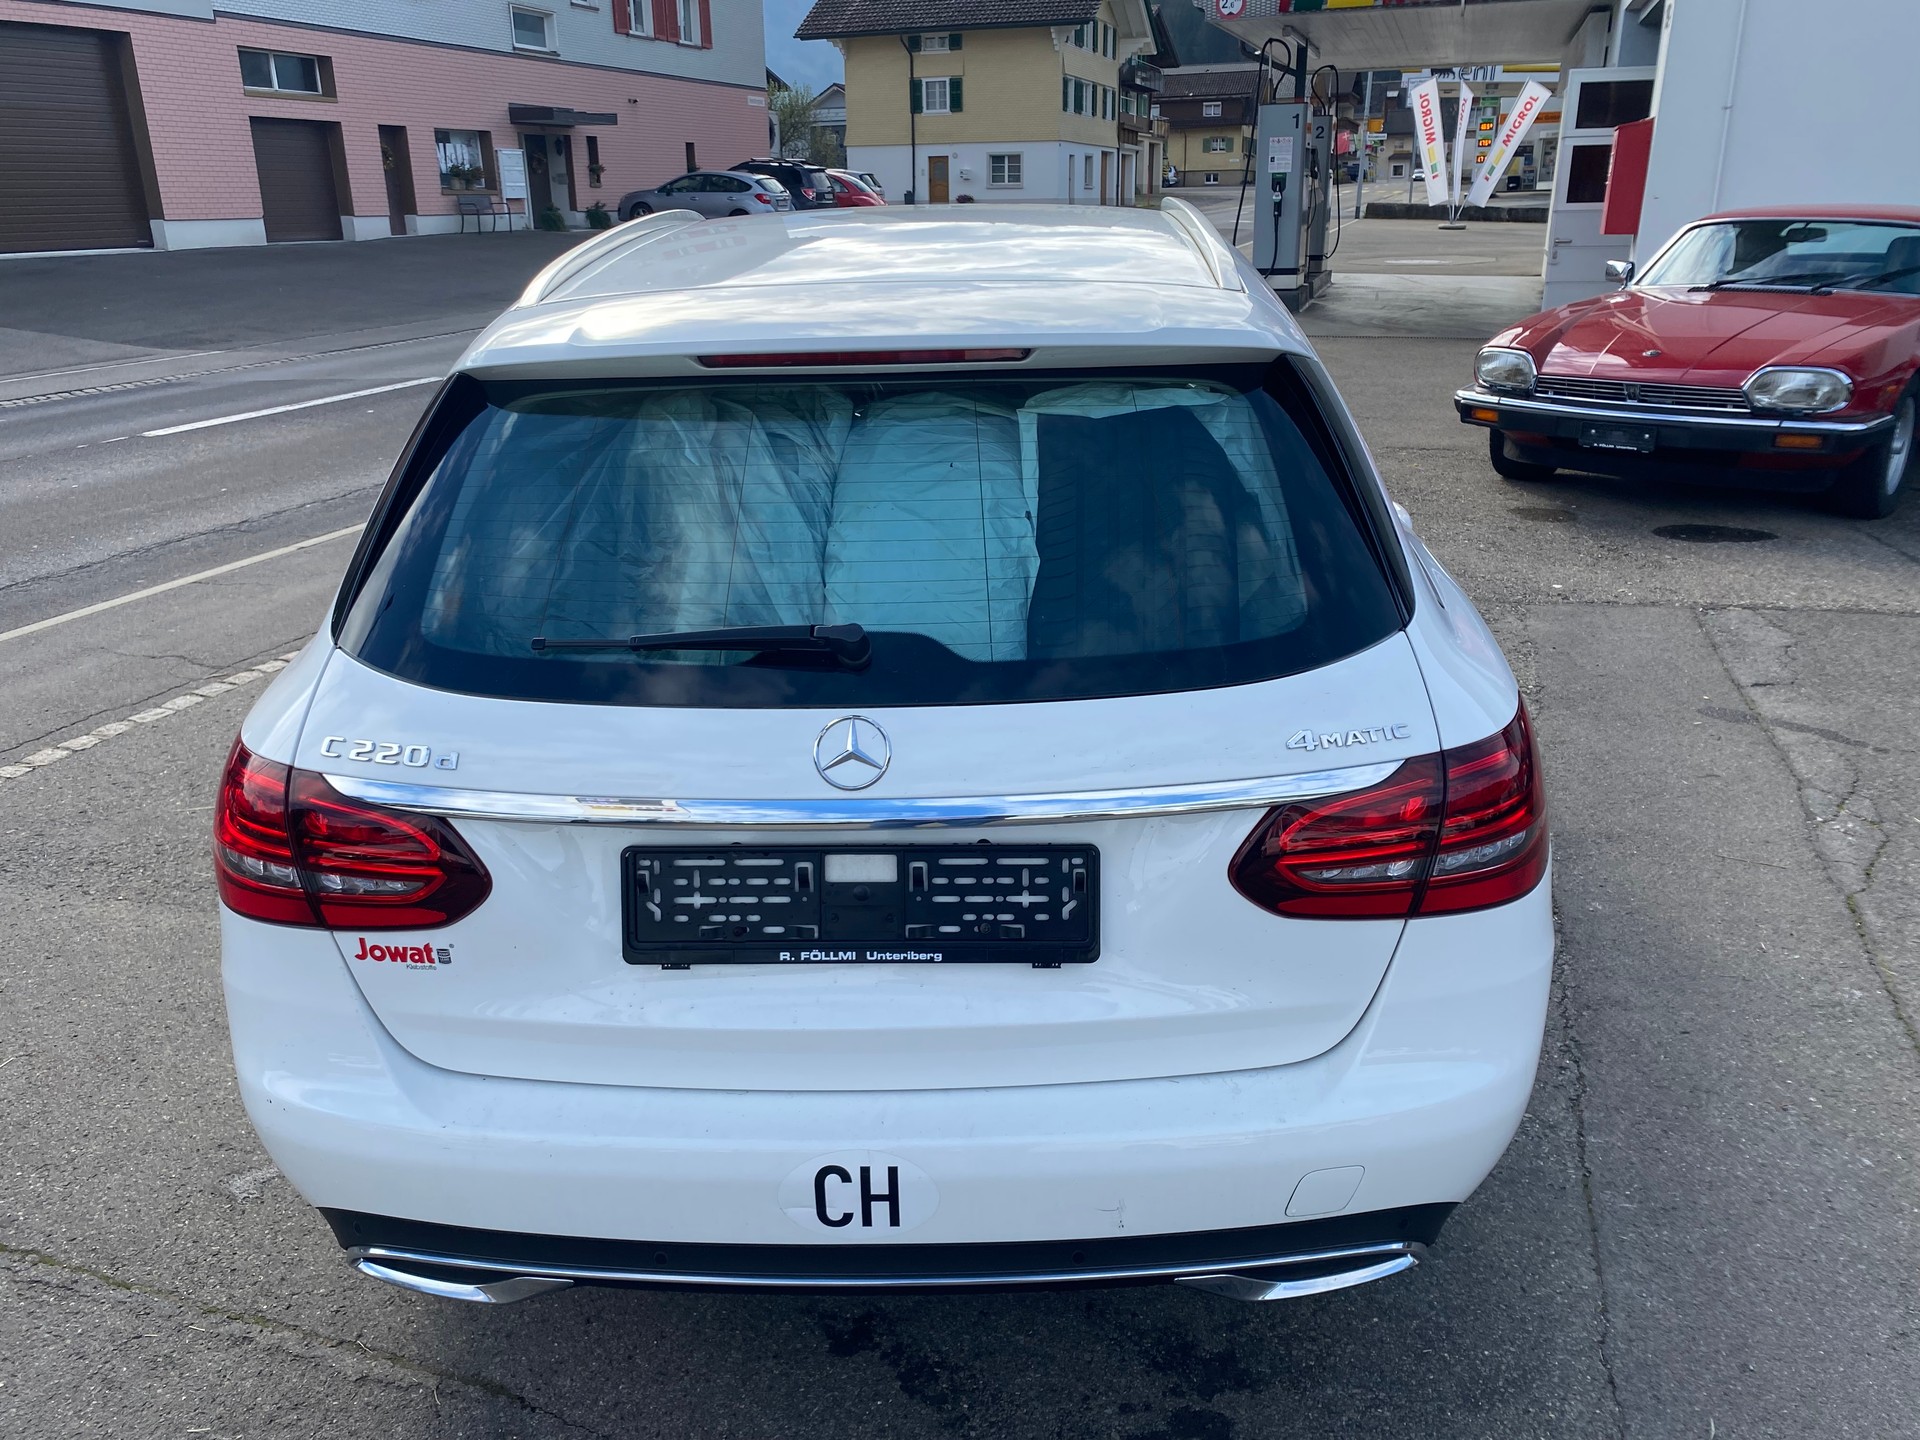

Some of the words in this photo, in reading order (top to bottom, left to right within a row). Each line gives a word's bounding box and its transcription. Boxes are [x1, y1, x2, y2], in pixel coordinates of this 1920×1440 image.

[1292, 113, 1300, 129] 1
[1315, 126, 1325, 139] 2
[1502, 94, 1540, 148] MIGROL
[1286, 724, 1412, 751] 4MATIC
[320, 735, 347, 758] C
[348, 739, 432, 768] 220
[434, 751, 460, 770] d
[354, 936, 436, 965] Jowat
[779, 951, 796, 961] R.
[800, 949, 857, 961] FÖLLMI
[866, 951, 943, 962] Unteriberg
[813, 1164, 901, 1228] CH
